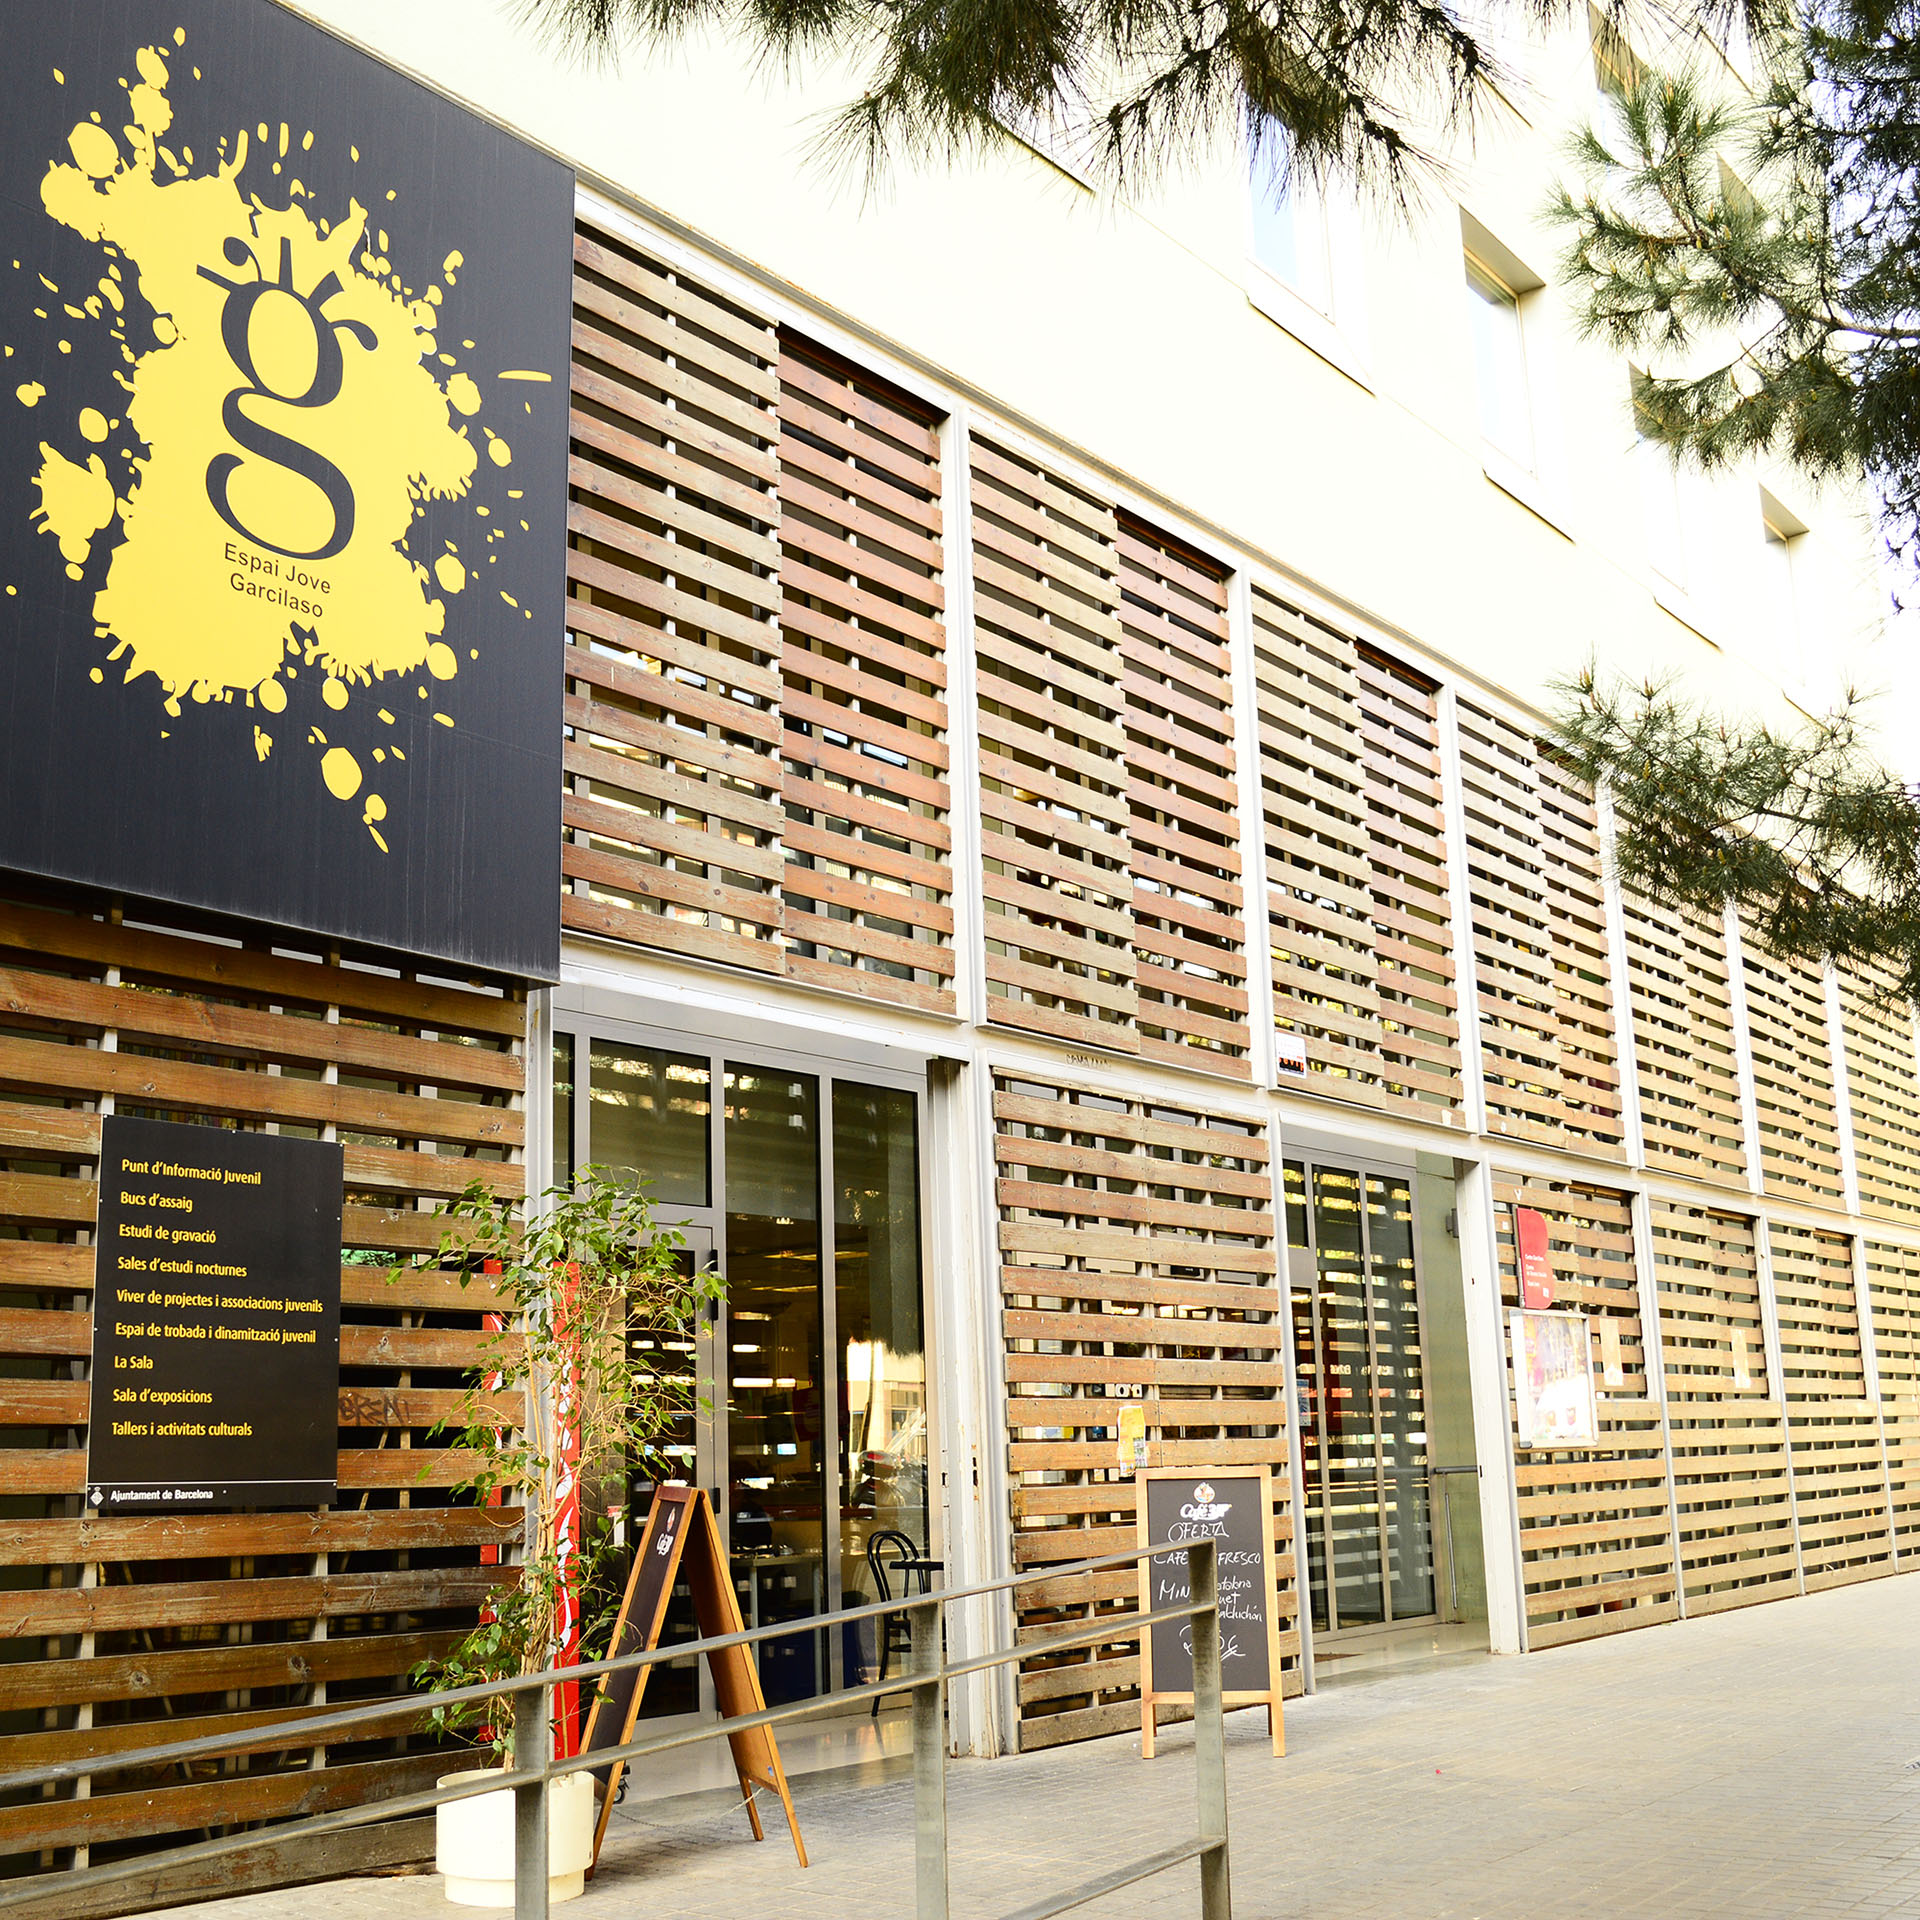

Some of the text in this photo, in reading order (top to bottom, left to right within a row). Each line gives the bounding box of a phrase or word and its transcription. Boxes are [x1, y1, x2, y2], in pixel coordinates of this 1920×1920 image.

[225, 542, 331, 594] Espai Jove
[230, 572, 323, 618] Garcilaso
[122, 1159, 261, 1184] Punt d'Informació Juvenil
[121, 1191, 192, 1212] Bucs d'assaig
[119, 1224, 216, 1243] Estudi de gravació
[118, 1256, 247, 1277] Sales d'estudi nocturnes
[117, 1289, 323, 1313] Viver de projectes i associacions juvenils
[115, 1322, 316, 1344] Espai de trobada i dinamització juvenil
[114, 1355, 153, 1369] La Sala
[113, 1388, 212, 1405] Sala d'exposicions
[112, 1421, 252, 1436] Tallers i activitats culturals
[111, 1489, 213, 1502] Ajuntament de Barcelona
[1168, 1521, 1229, 1543] OFERTA
[1218, 1551, 1261, 1566] FRESCO
[1217, 1593, 1241, 1604] uet
